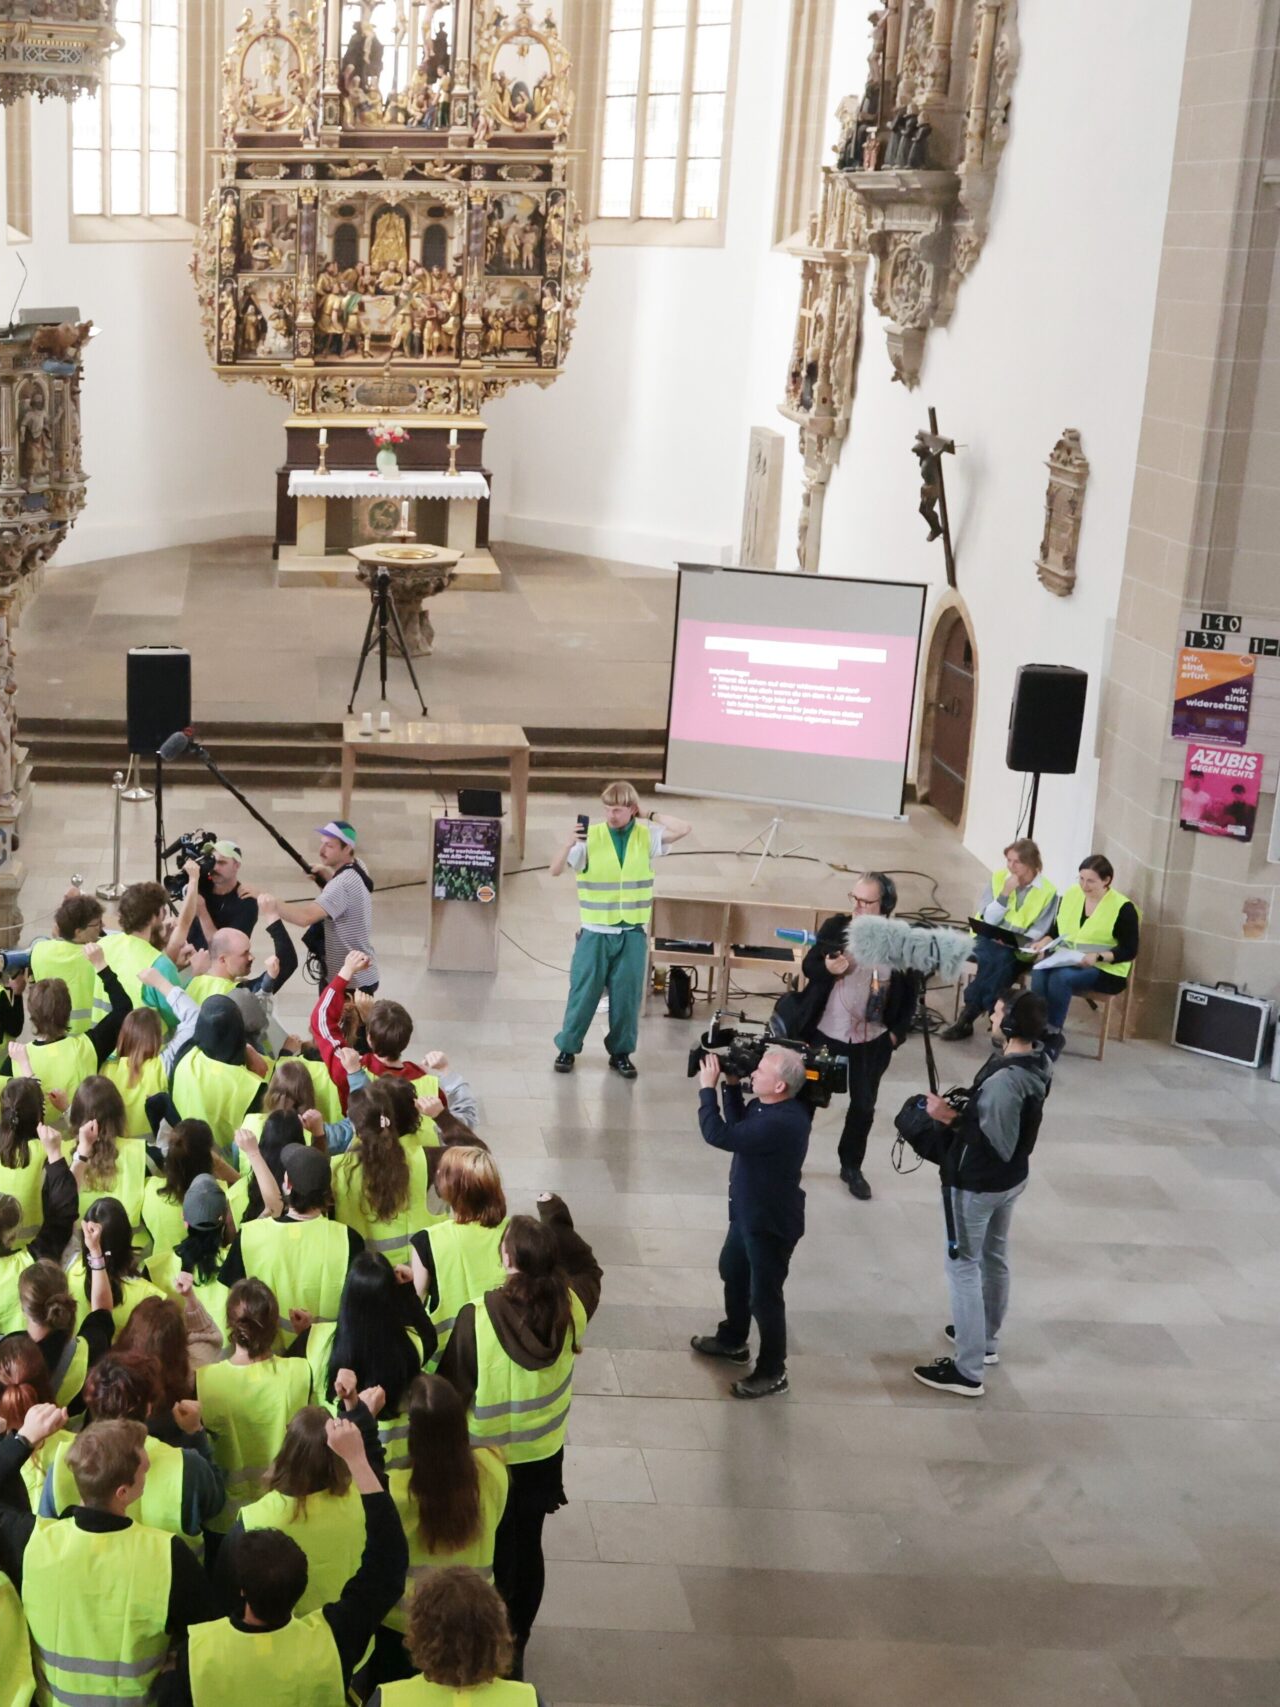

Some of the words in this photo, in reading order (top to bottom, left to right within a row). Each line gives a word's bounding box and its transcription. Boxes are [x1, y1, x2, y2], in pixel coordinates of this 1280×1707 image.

[1190, 632, 1223, 649] 139
[1183, 654, 1201, 662] wir.
[1182, 663, 1206, 672] sind.
[1181, 672, 1210, 680] erfurt.
[1232, 686, 1250, 696] wir.
[1224, 694, 1248, 704] sind.
[1186, 698, 1248, 712] widersetzen.
[1190, 748, 1258, 771] AZUBIS
[1191, 764, 1219, 774] GEGEN
[1220, 768, 1255, 779] RECHTS
[456, 848, 491, 856] verhindern
[450, 854, 496, 862] AfD-Parteitag
